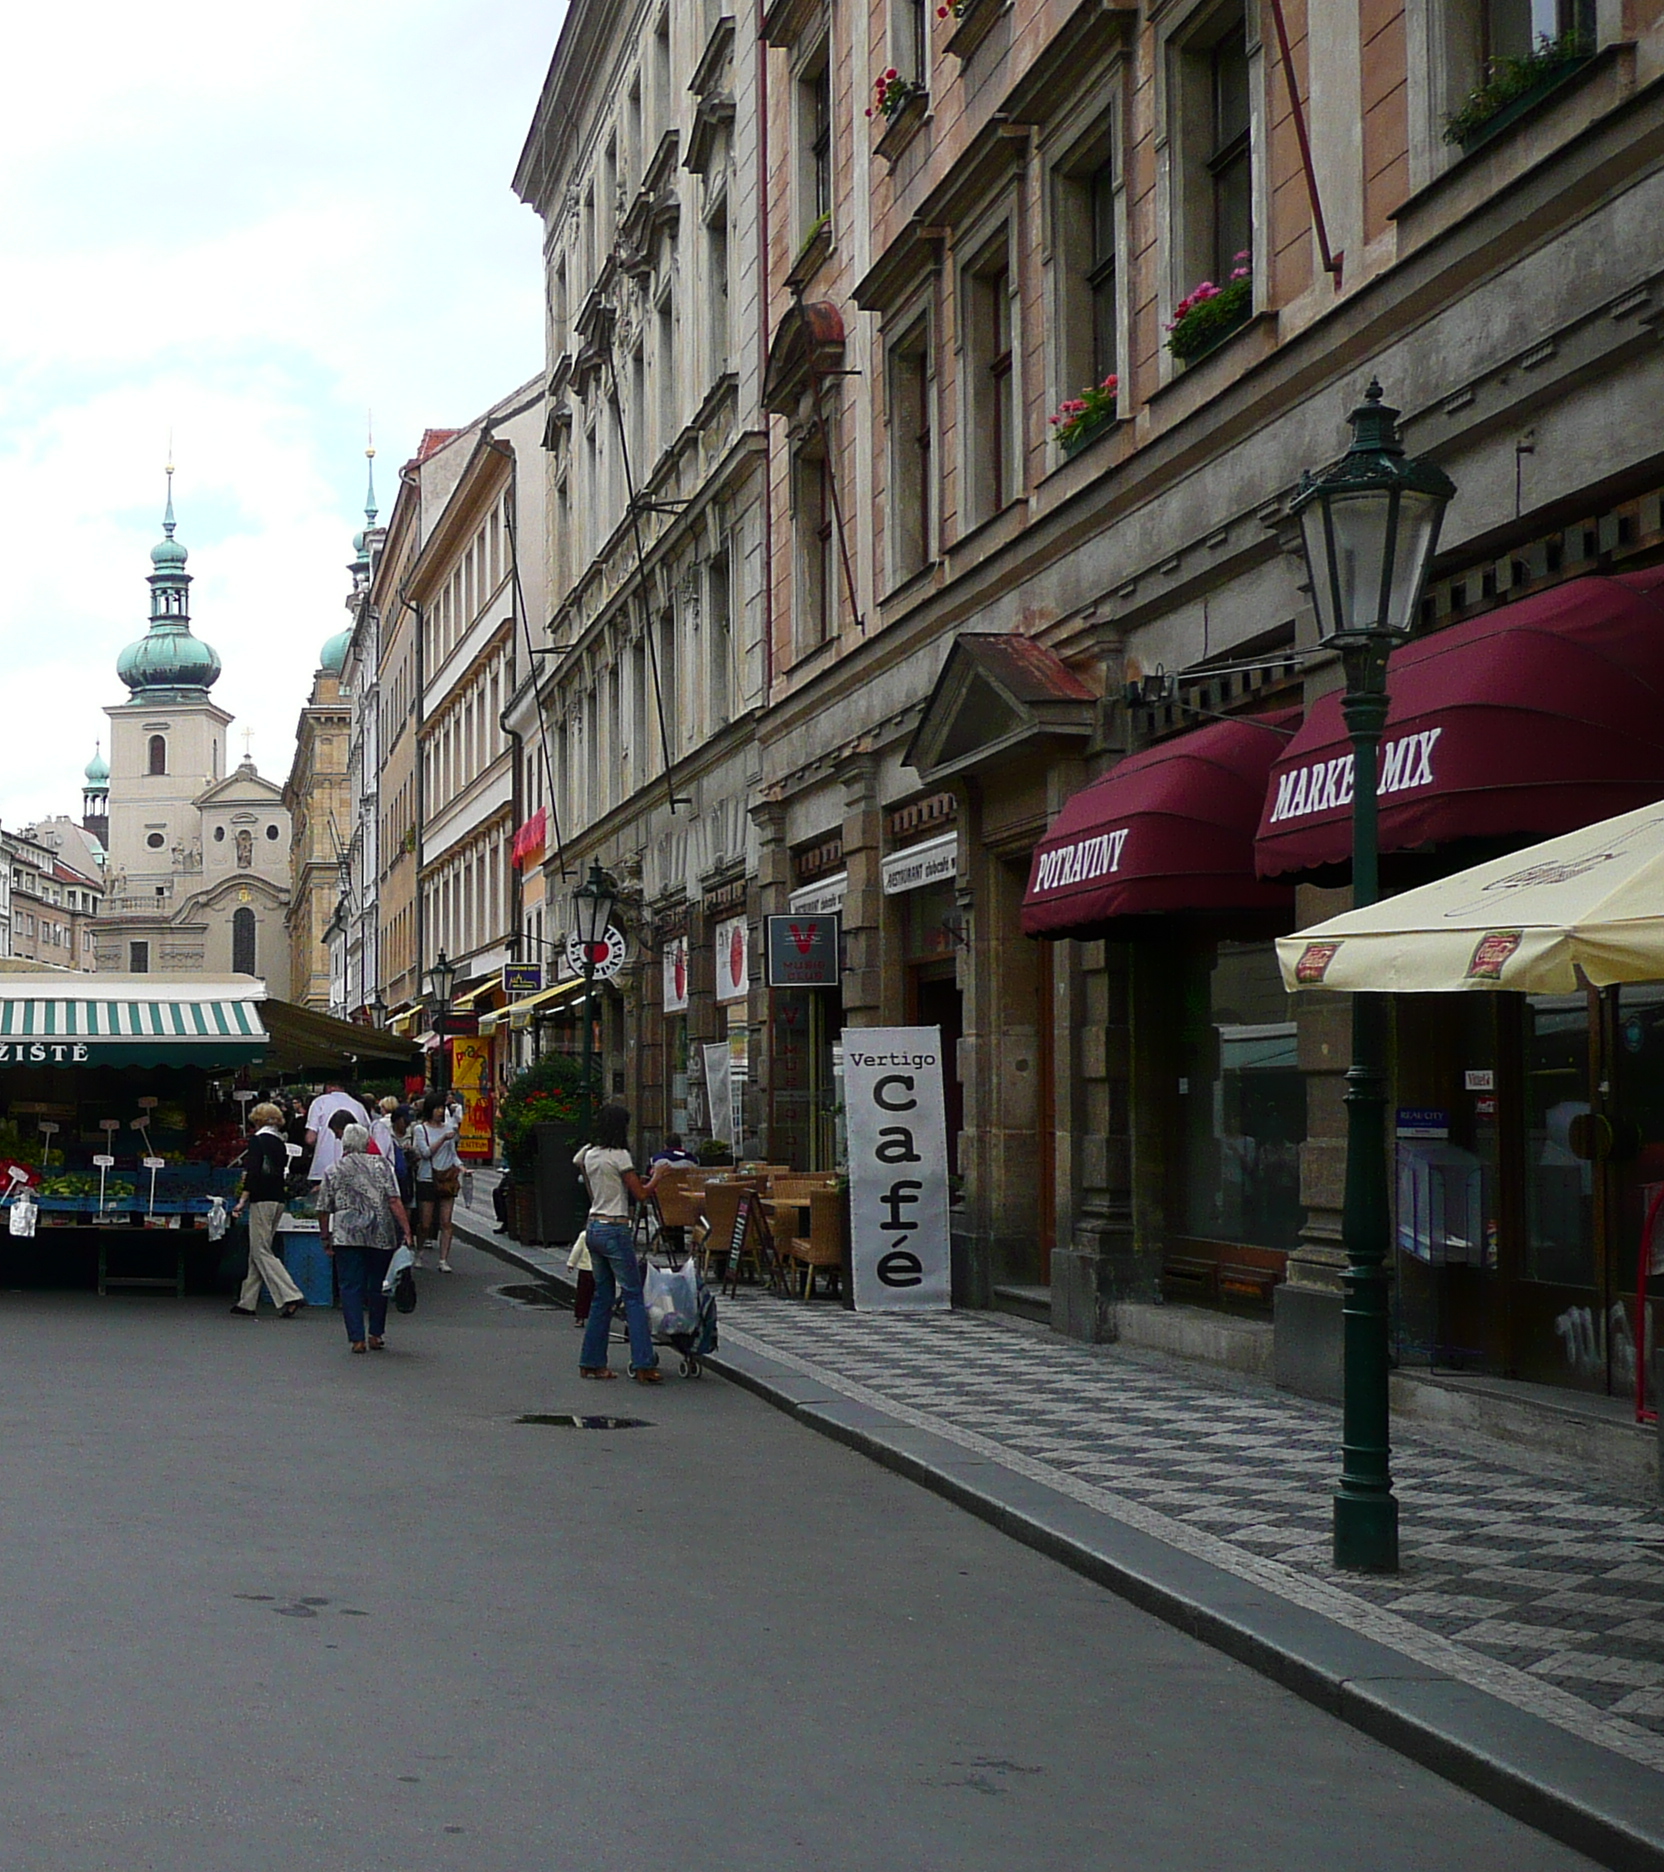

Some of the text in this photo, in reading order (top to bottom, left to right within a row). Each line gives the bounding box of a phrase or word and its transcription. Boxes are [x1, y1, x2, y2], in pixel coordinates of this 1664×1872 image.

[1270, 728, 1442, 823] MARKE MIX
[1033, 828, 1129, 893] POTRAVINY
[850, 1053, 936, 1069] Vertigo
